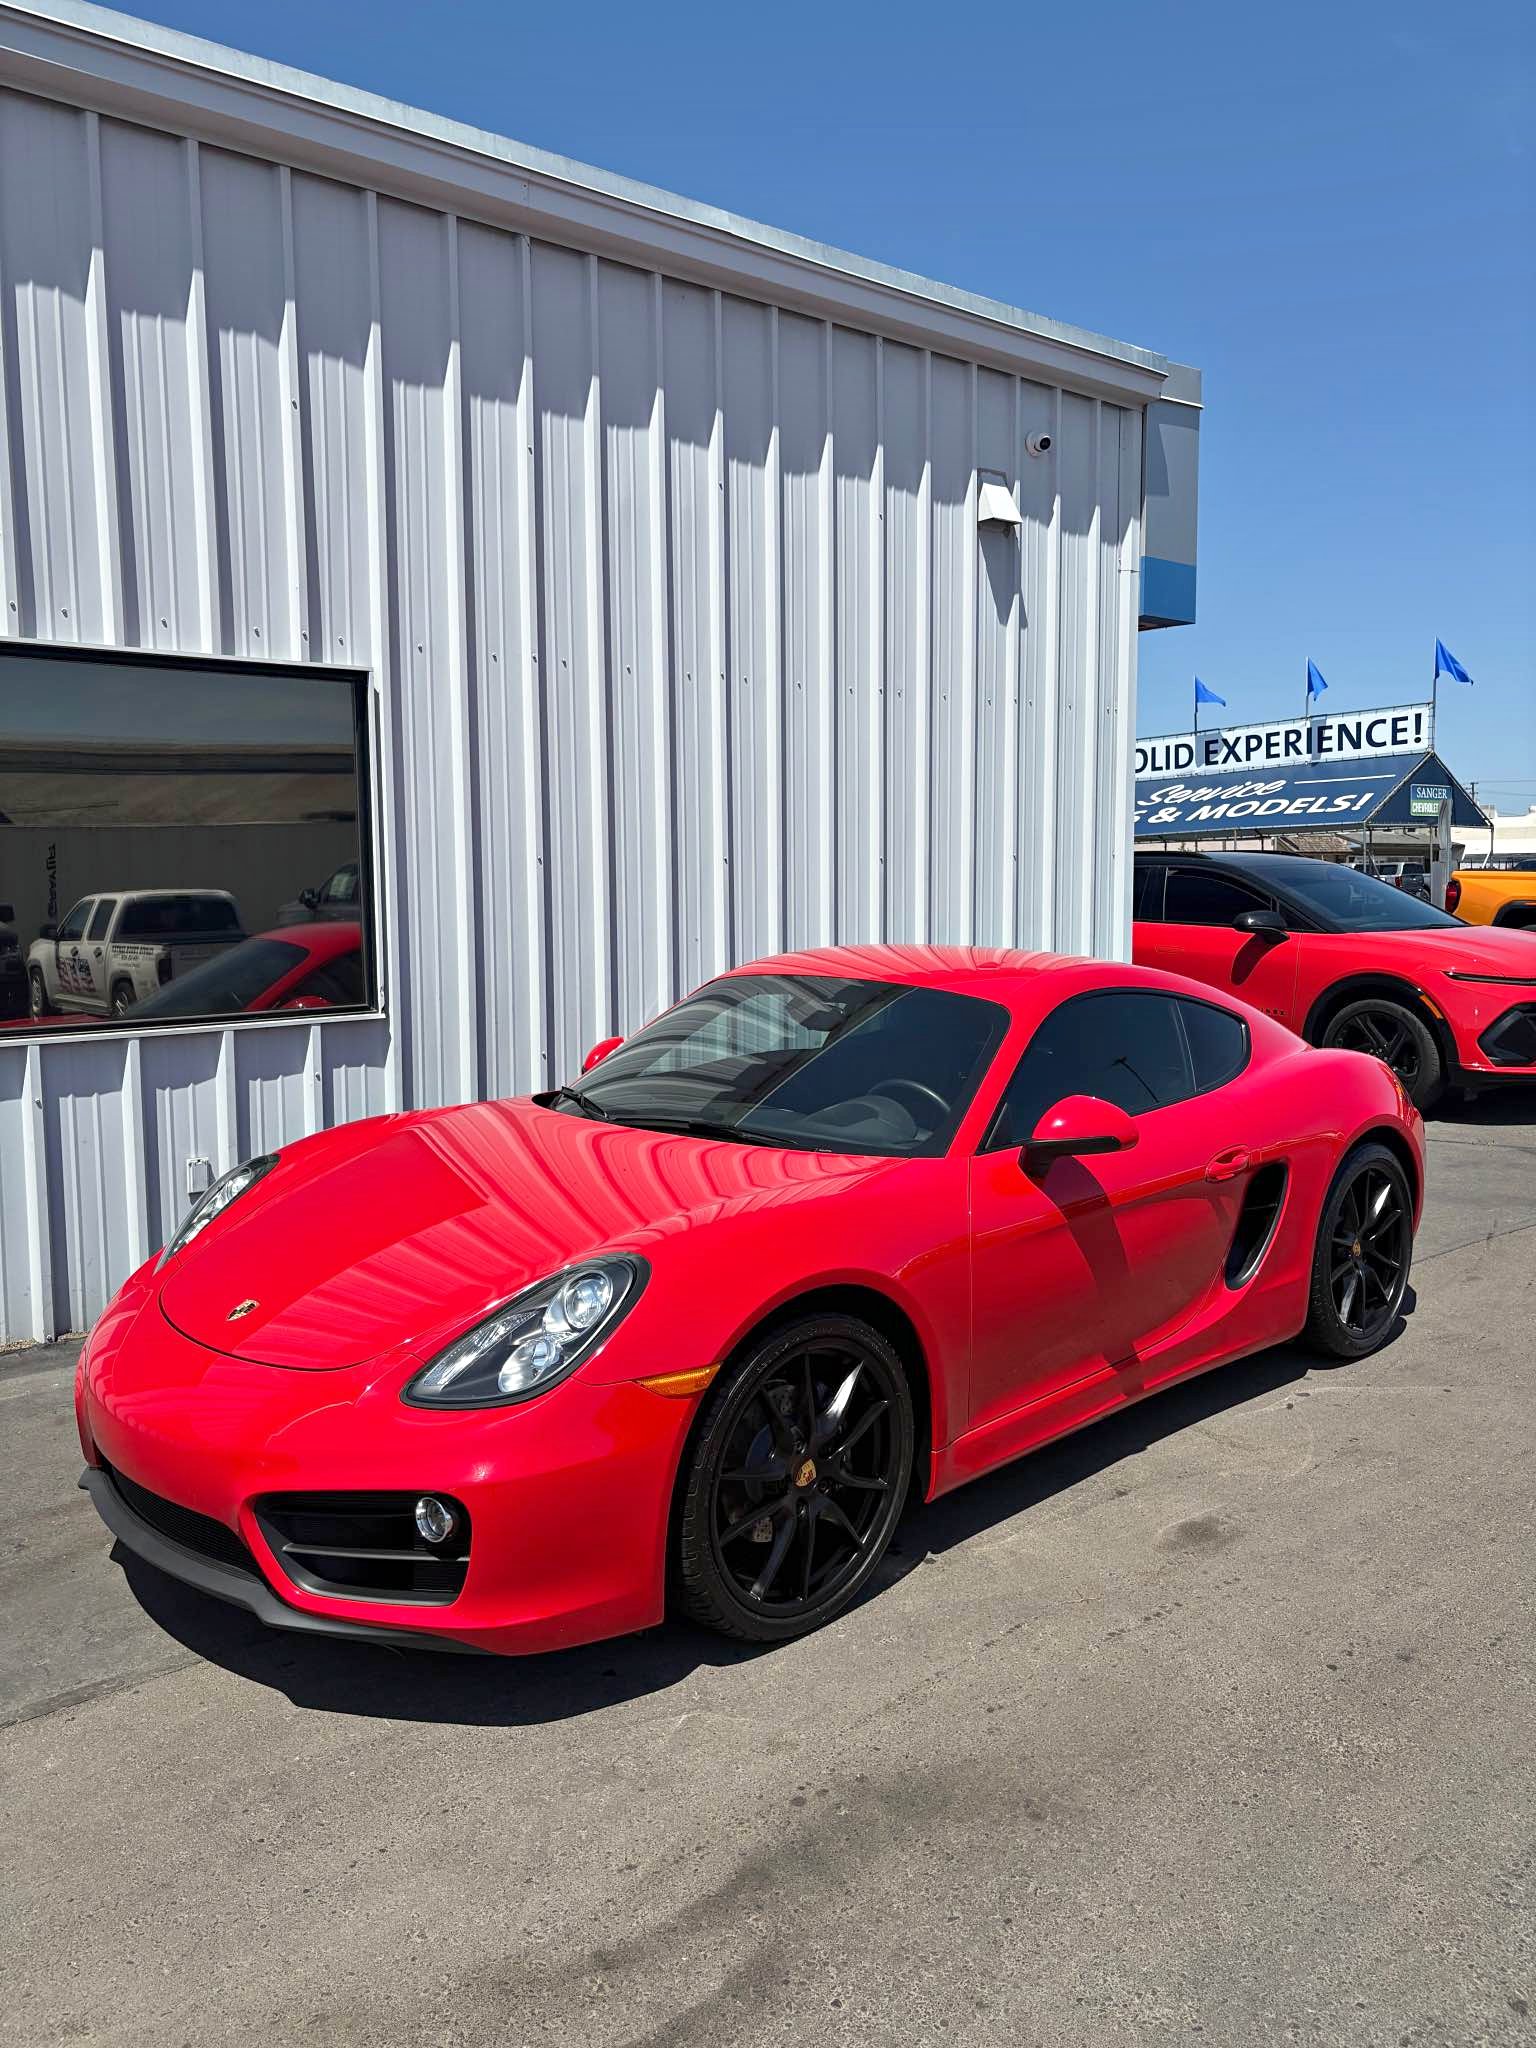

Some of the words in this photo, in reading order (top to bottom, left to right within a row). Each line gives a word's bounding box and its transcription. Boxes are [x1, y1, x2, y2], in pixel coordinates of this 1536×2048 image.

[1135, 743, 1194, 773] OLID
[1204, 713, 1422, 765] EXPERIENCE!
[1137, 779, 1287, 806] Service
[1416, 787, 1448, 799] SANGER
[1147, 807, 1183, 824] &
[1185, 792, 1374, 823] MODELS!
